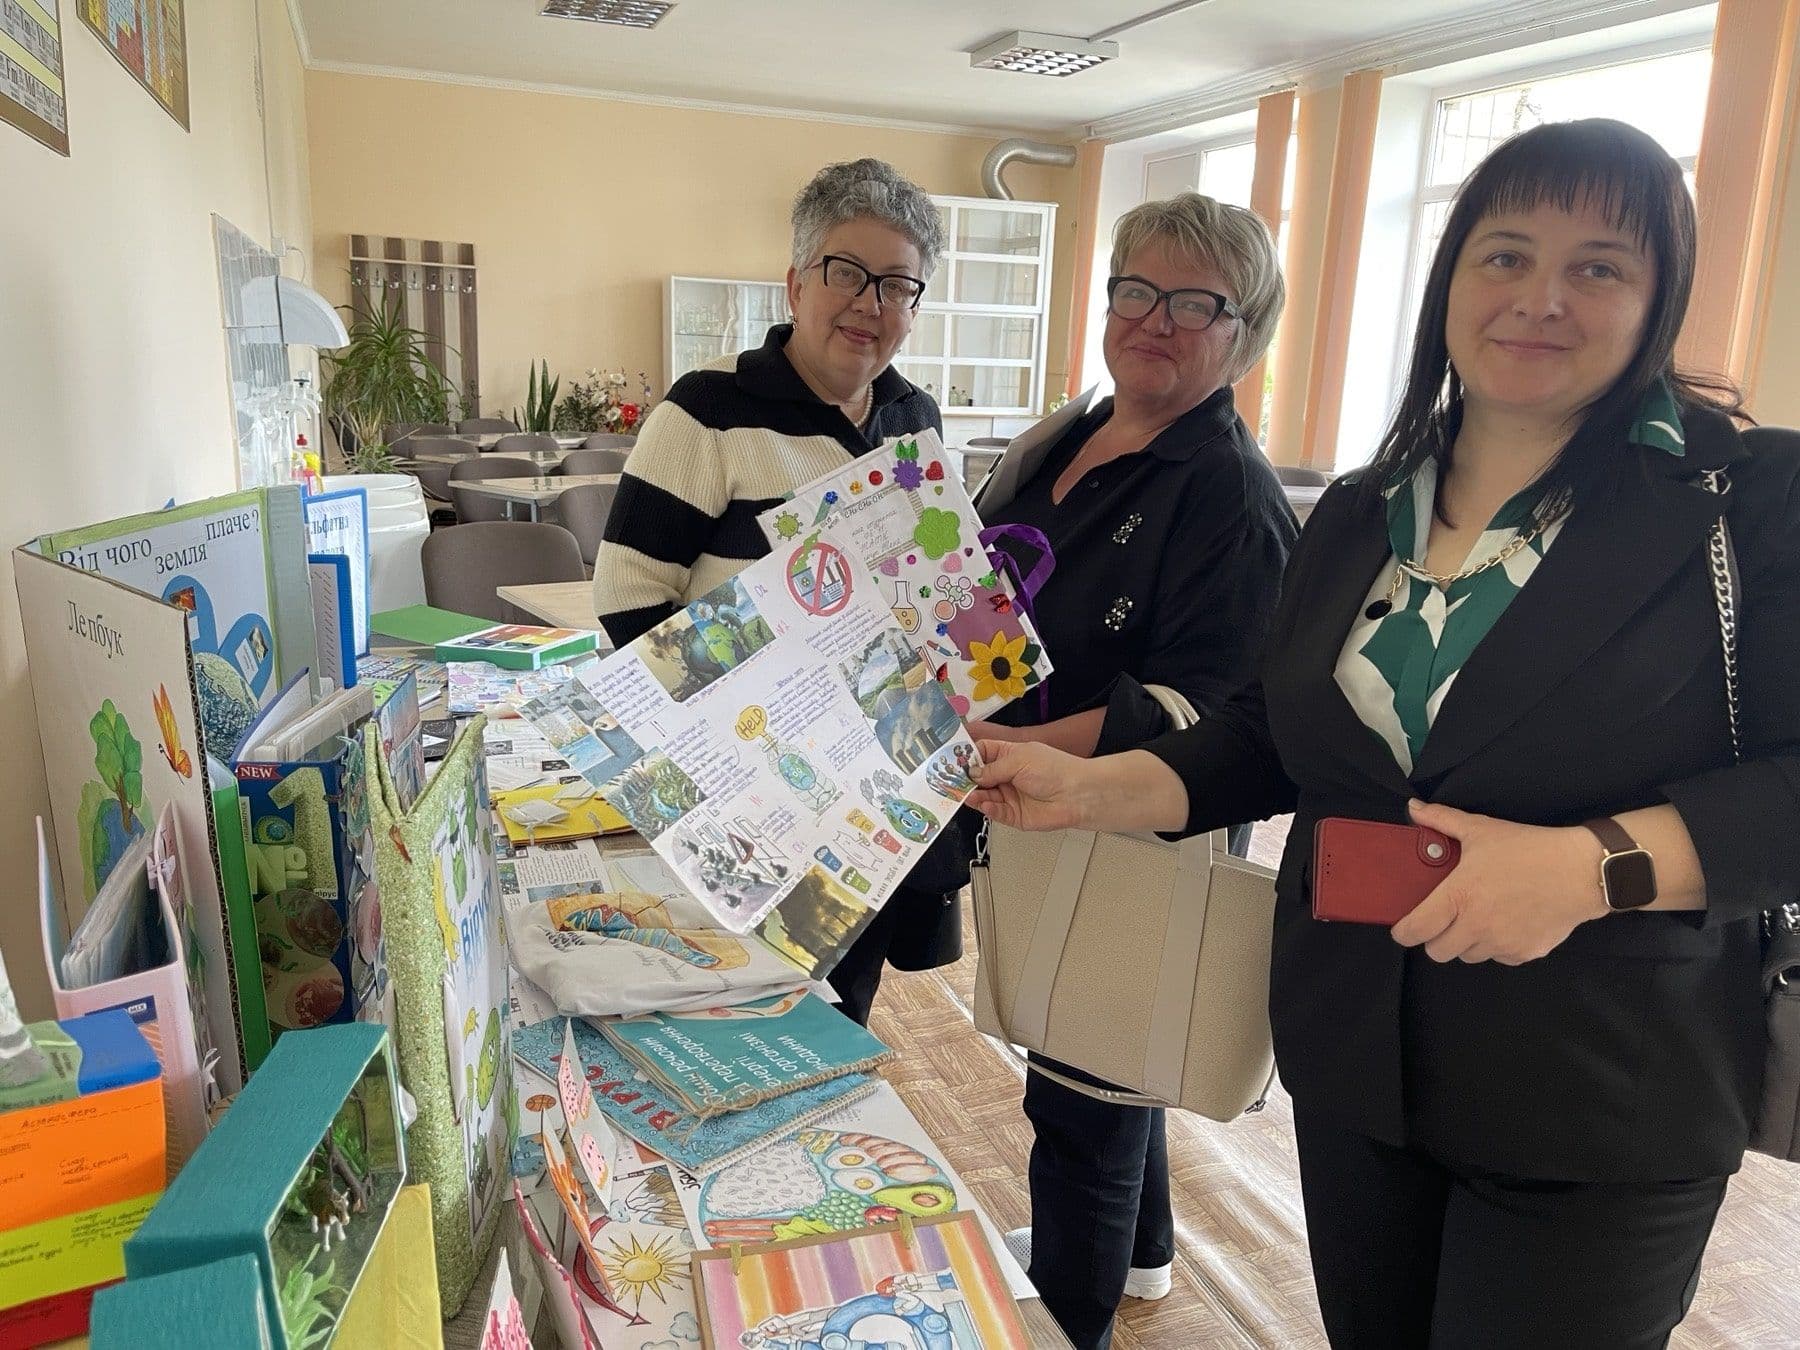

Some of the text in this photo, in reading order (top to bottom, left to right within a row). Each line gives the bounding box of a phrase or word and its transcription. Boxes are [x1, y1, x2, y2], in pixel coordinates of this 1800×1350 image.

[106, 538, 152, 566] чого
[155, 542, 208, 574] земля
[67, 600, 124, 659] Лепбук
[240, 767, 273, 778] NEW
[638, 1037, 697, 1073] речовин
[660, 1025, 740, 1083] перетворення
